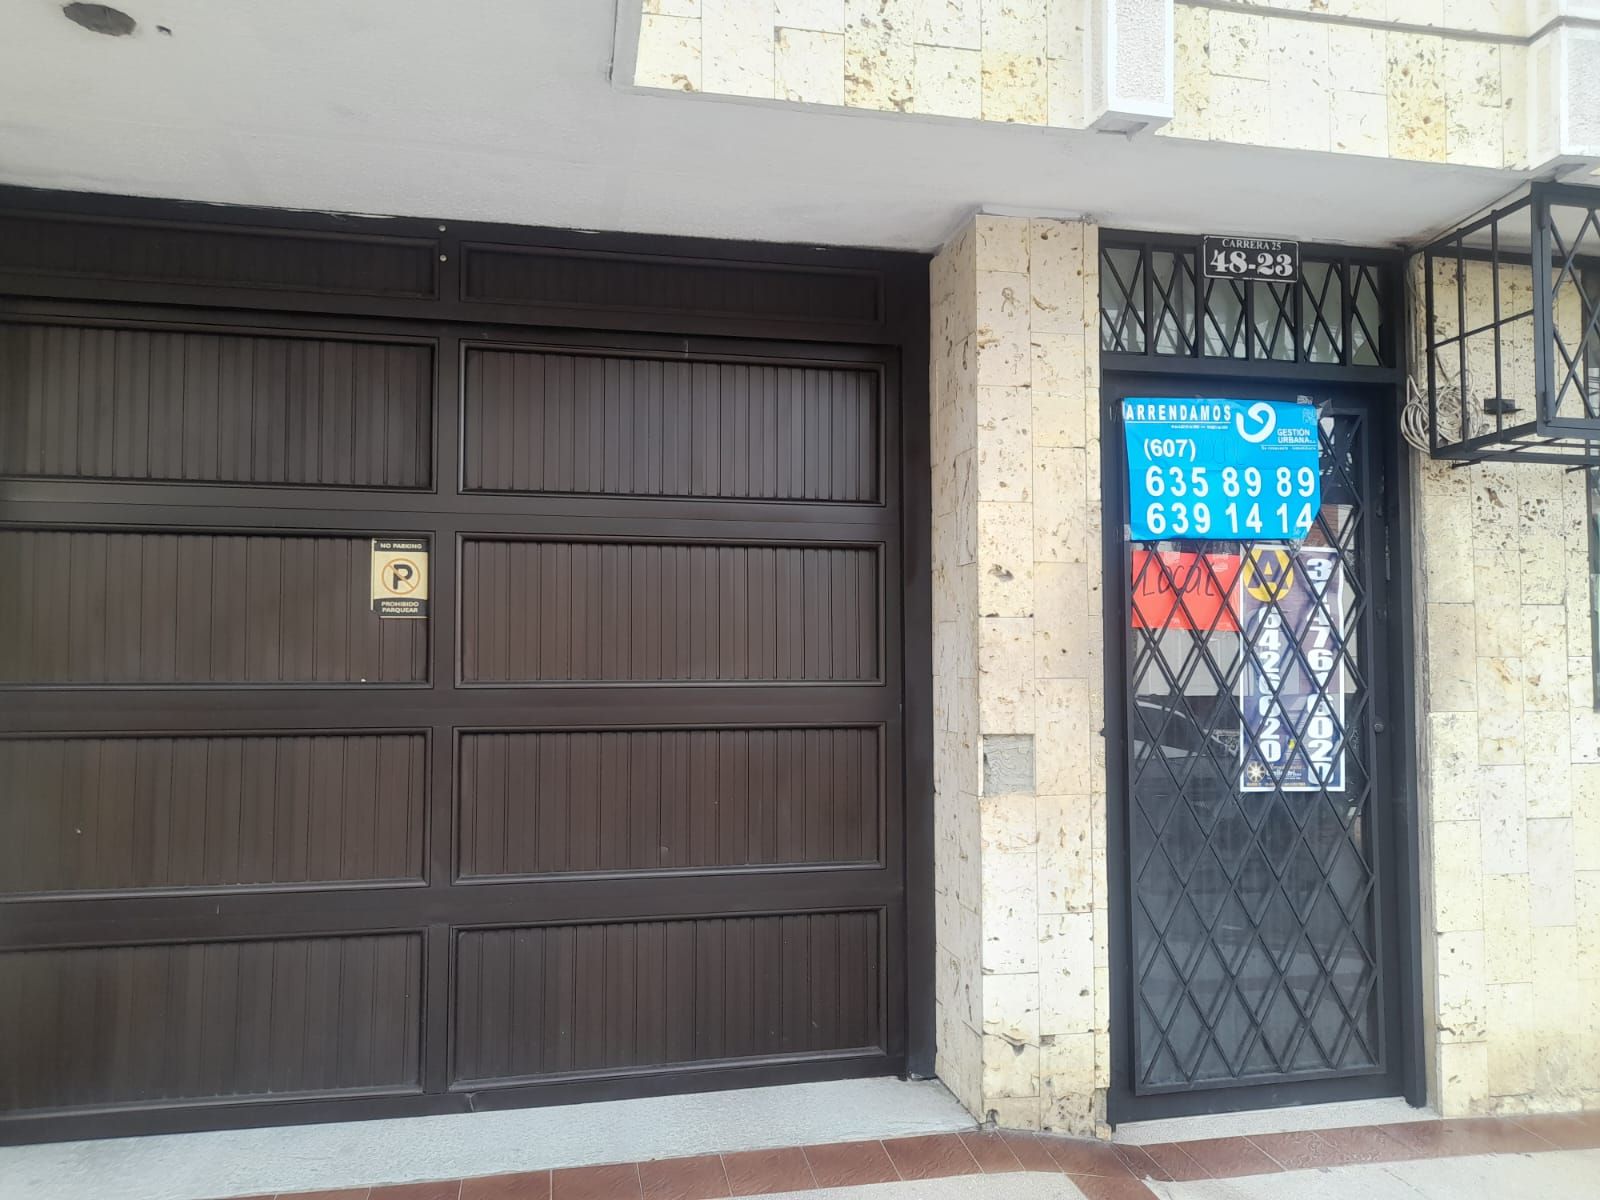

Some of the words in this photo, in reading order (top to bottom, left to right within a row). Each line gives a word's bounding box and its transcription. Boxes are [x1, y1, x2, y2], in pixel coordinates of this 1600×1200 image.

[1222, 239, 1270, 250] CARRERA
[1271, 242, 1281, 250] 25
[1210, 249, 1293, 276] 48-23
[1126, 404, 1231, 421] ARRENDAMOS
[1143, 438, 1196, 462] (607)
[1278, 436, 1309, 444] URBANA
[1145, 465, 1209, 497] 635
[1222, 466, 1262, 497] 89
[1276, 466, 1315, 497] 89
[1146, 502, 1211, 534] 639
[1225, 502, 1263, 533] 14
[1276, 502, 1313, 533] 14
